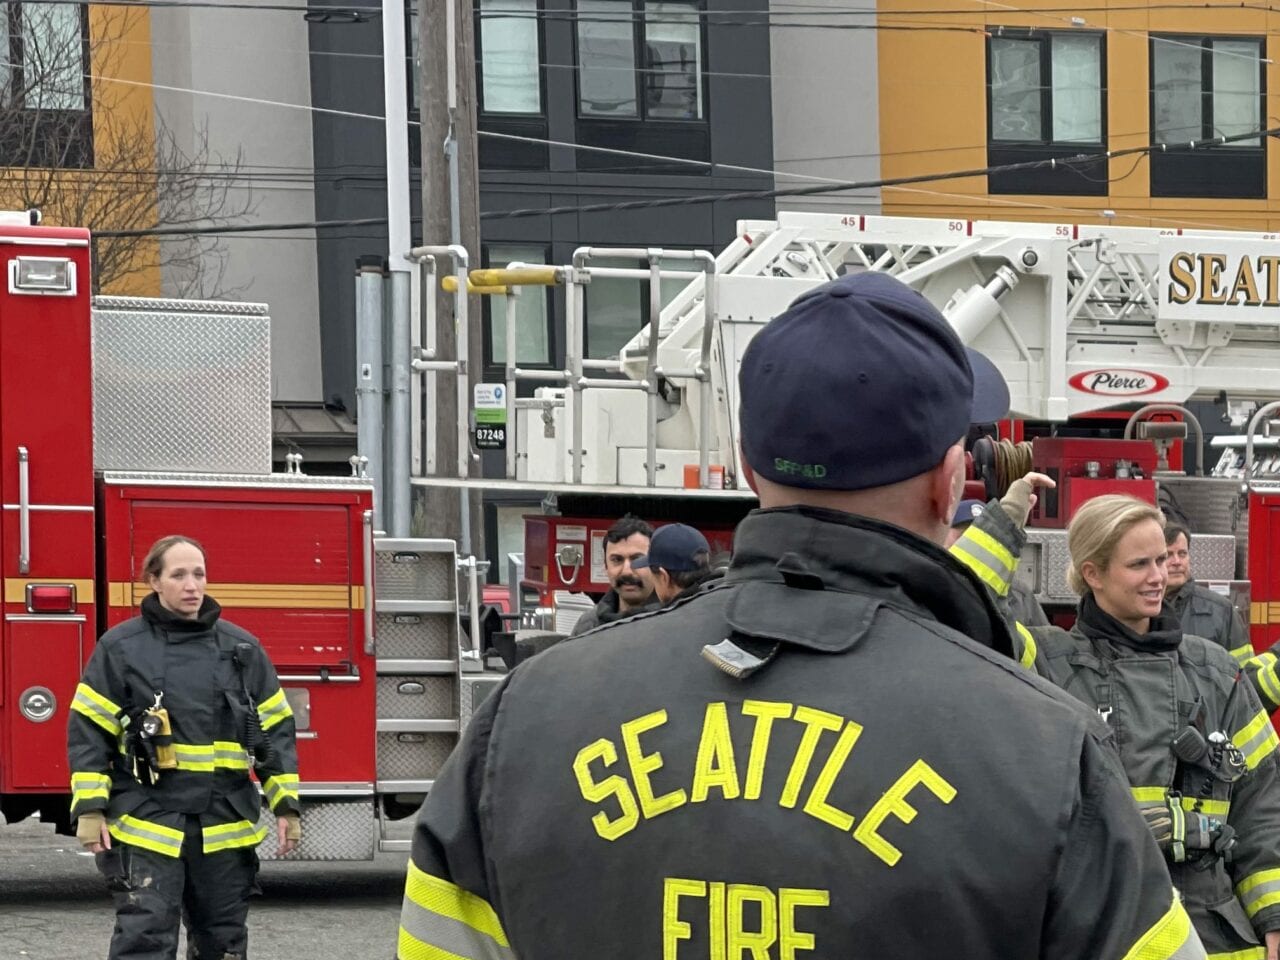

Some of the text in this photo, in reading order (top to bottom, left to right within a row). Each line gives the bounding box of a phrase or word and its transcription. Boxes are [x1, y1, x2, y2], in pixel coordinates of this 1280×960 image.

[840, 216, 856, 227] 45
[948, 221, 963, 232] 50
[1055, 226, 1069, 236] 55
[1090, 372, 1146, 390] Pierce
[476, 429, 504, 441] 87248
[572, 699, 957, 866] SEATTLE
